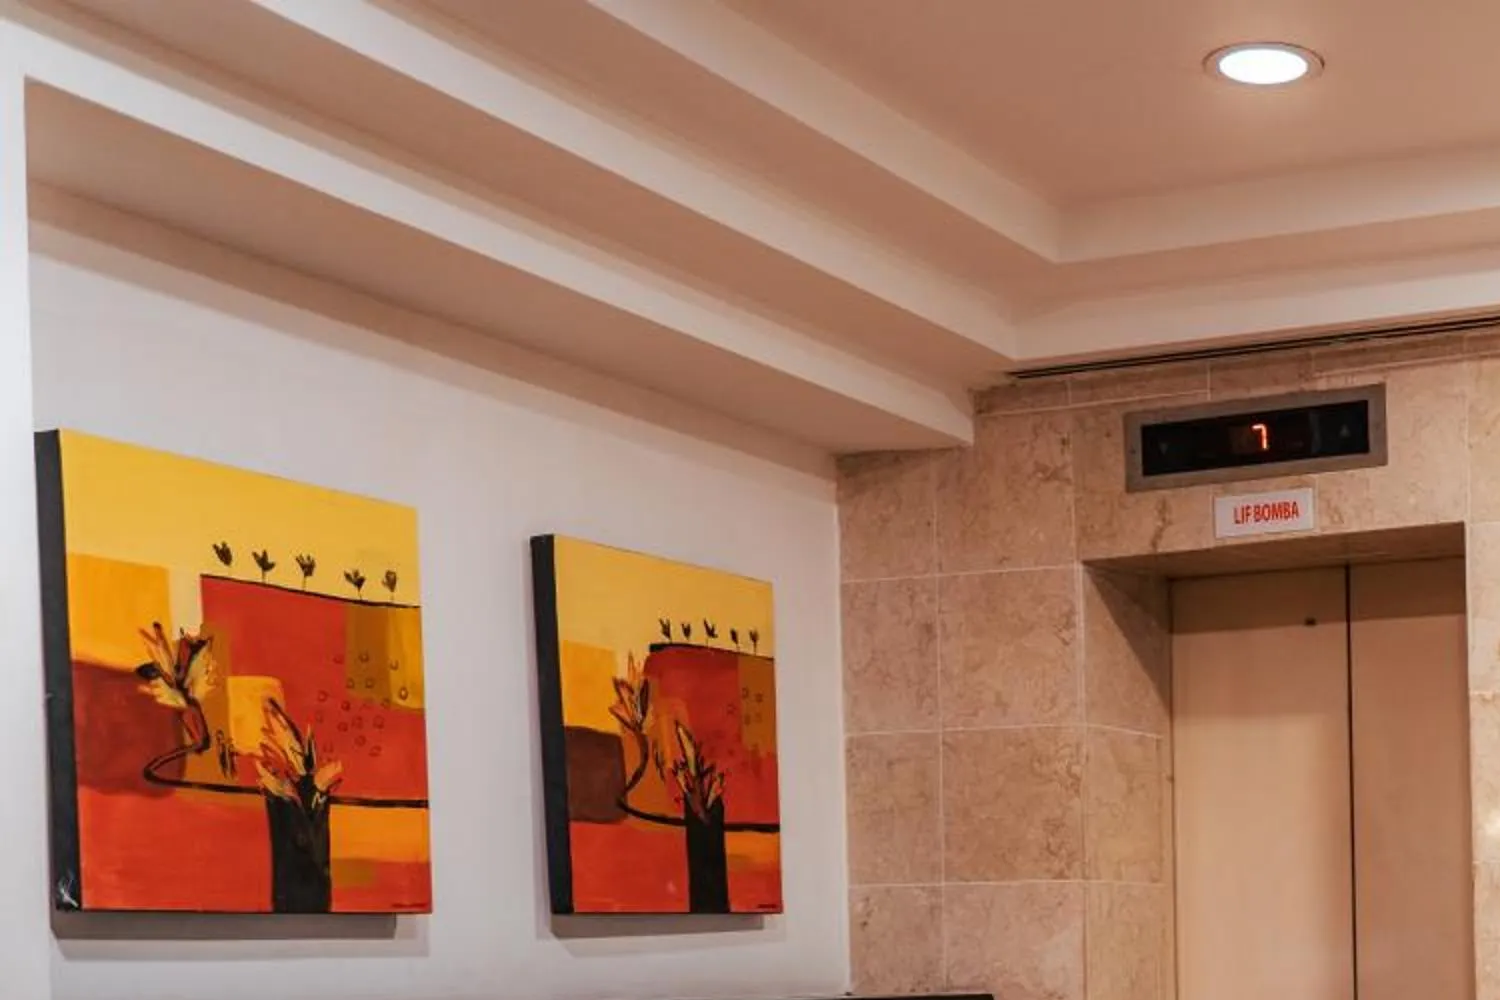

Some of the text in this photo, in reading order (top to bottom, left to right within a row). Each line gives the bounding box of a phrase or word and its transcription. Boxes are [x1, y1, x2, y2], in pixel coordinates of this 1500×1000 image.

[1252, 423, 1269, 451] 7
[1233, 501, 1299, 524] LIF BOMBA
